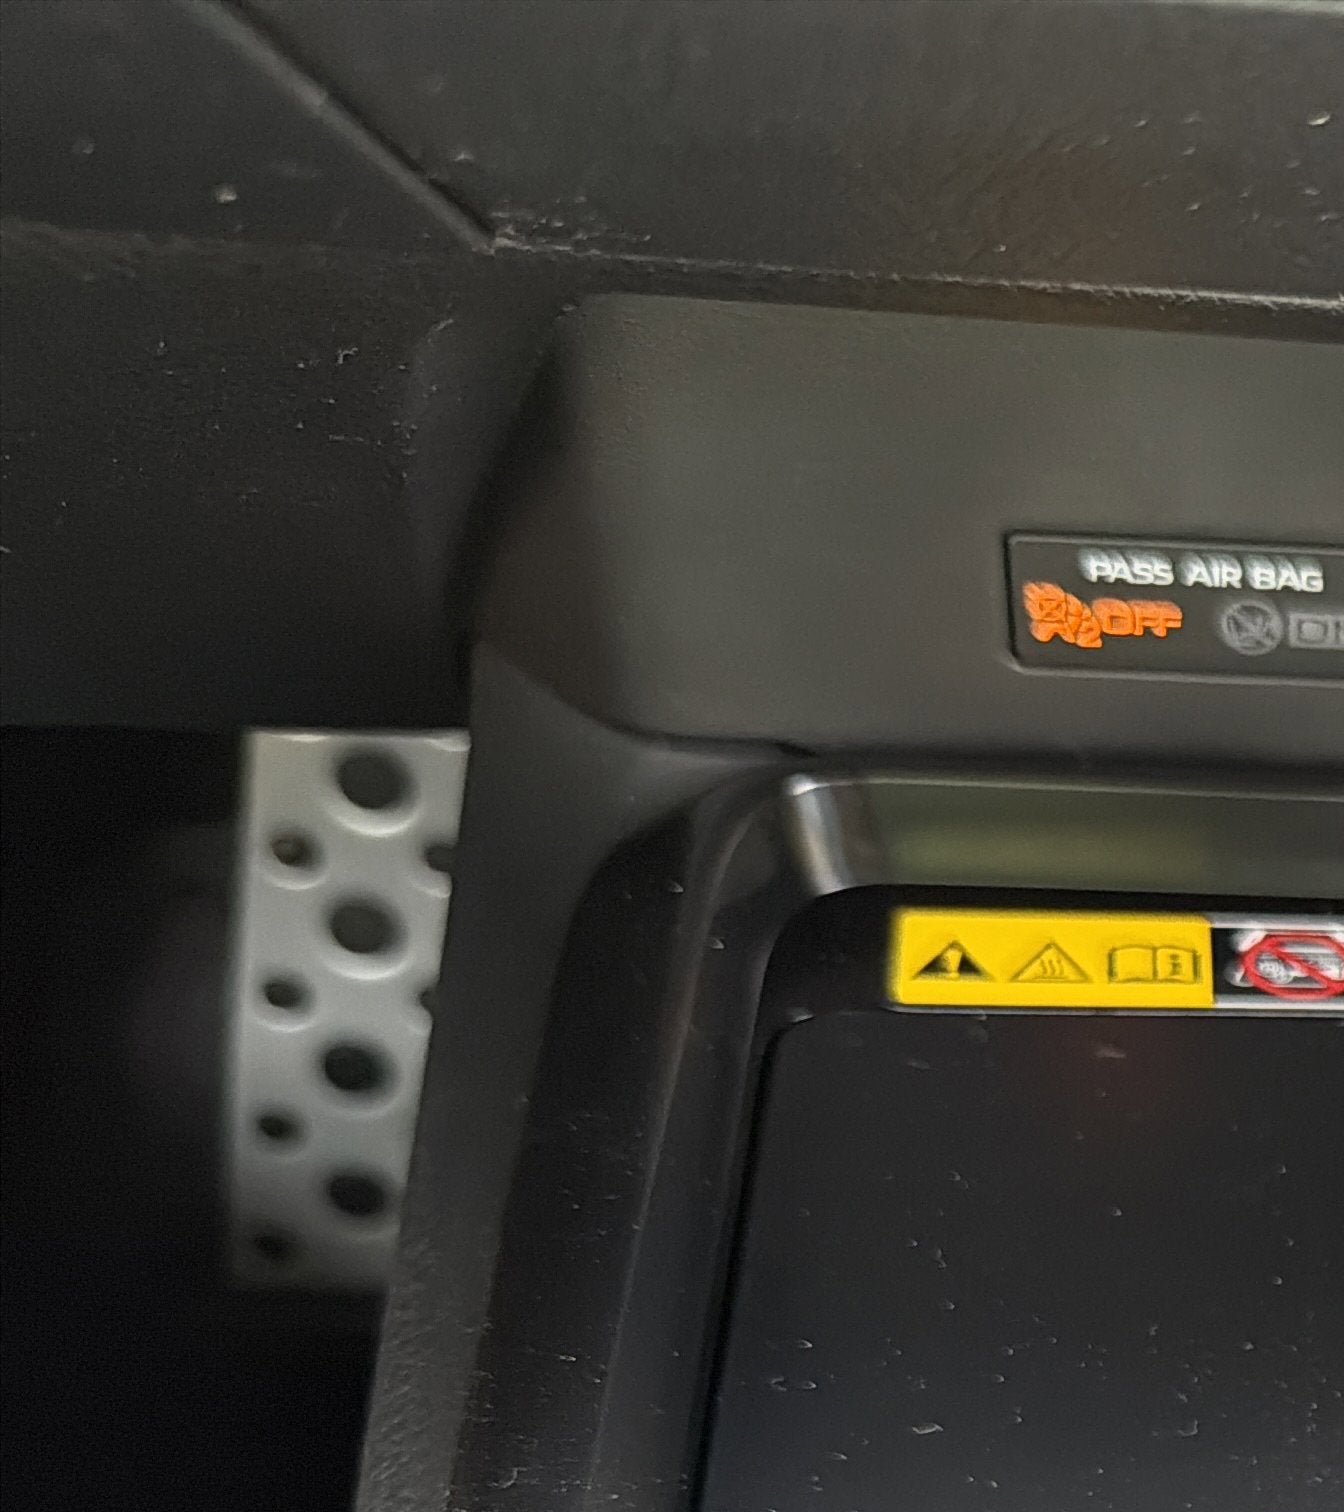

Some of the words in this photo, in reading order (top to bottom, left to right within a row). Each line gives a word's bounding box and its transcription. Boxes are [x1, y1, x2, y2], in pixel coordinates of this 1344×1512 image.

[1081, 551, 1175, 586] PASS
[1182, 554, 1243, 589] AIR
[1246, 557, 1325, 592] BAG
[1093, 598, 1183, 638] OFF
